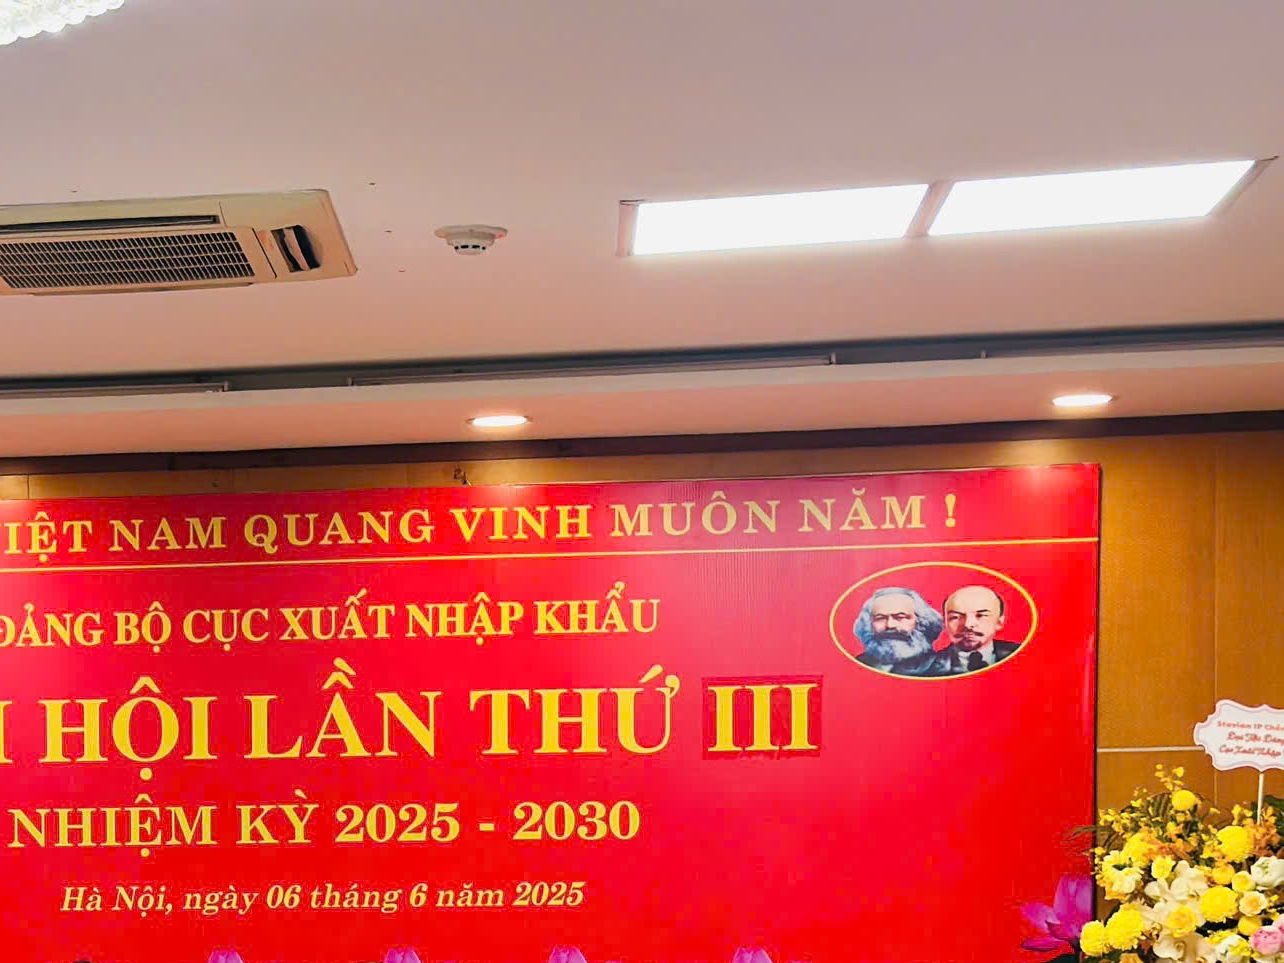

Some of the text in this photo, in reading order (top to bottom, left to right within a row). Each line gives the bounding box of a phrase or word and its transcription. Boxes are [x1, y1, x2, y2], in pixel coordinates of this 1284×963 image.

[109, 517, 226, 552] NAM
[244, 509, 434, 554] QUANG
[449, 505, 592, 542] VINH
[609, 491, 781, 537] MUÔN
[796, 488, 927, 533] NĂM
[944, 494, 957, 528] !
[114, 602, 172, 653] BỘ
[183, 608, 269, 652] CỤC
[280, 589, 396, 640] XUẤT
[405, 592, 524, 646] NHẬP
[534, 581, 661, 634] KHẨU
[38, 676, 218, 780] HỘI
[243, 657, 442, 759] LẦN
[469, 664, 681, 755] THỨ
[708, 683, 818, 752] III
[7, 793, 218, 857] NHIỆM
[235, 789, 319, 844] KỲ
[334, 802, 460, 843] 2025
[513, 800, 640, 841] 2030
[60, 881, 586, 918] Hà Nội, ngày 06 tháng 6 năm 2025
